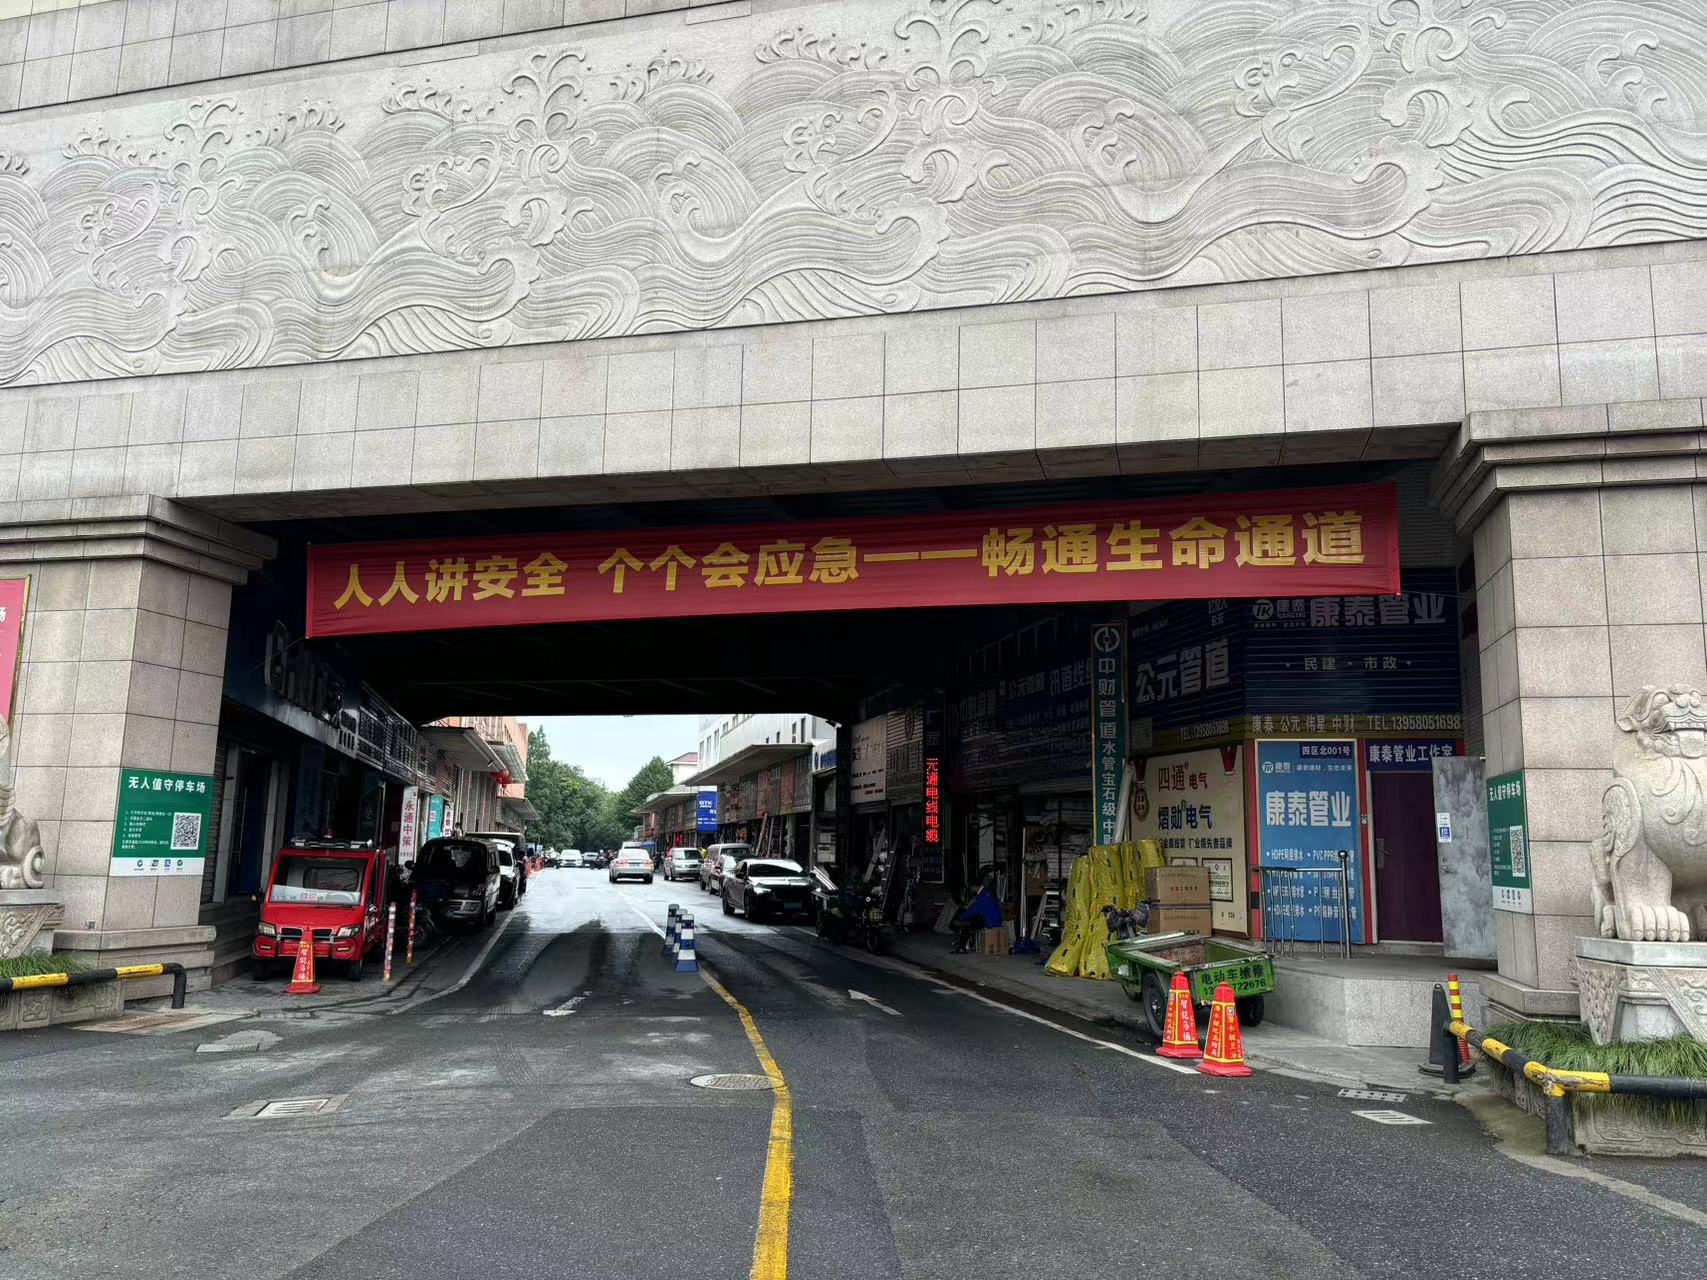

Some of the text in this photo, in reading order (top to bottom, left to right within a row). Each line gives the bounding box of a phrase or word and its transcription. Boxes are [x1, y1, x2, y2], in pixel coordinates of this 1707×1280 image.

[333, 510, 1366, 610] 人人讲安全 个个会应急——畅通生命通道
[1310, 592, 1447, 628] 康泰管业
[1304, 656, 1398, 671] 民建 市政
[1252, 714, 1274, 734] 康泰
[1280, 714, 1301, 732] 公元
[1306, 714, 1326, 733] 伟星
[1332, 714, 1355, 734] 中财
[1302, 745, 1351, 756] 四区北001号
[1369, 743, 1454, 764] 康泰管业工作室
[128, 776, 206, 793] 无人值守停车场
[1489, 781, 1521, 802] 无人值守停车场
[1266, 790, 1352, 827] 康泰管业
